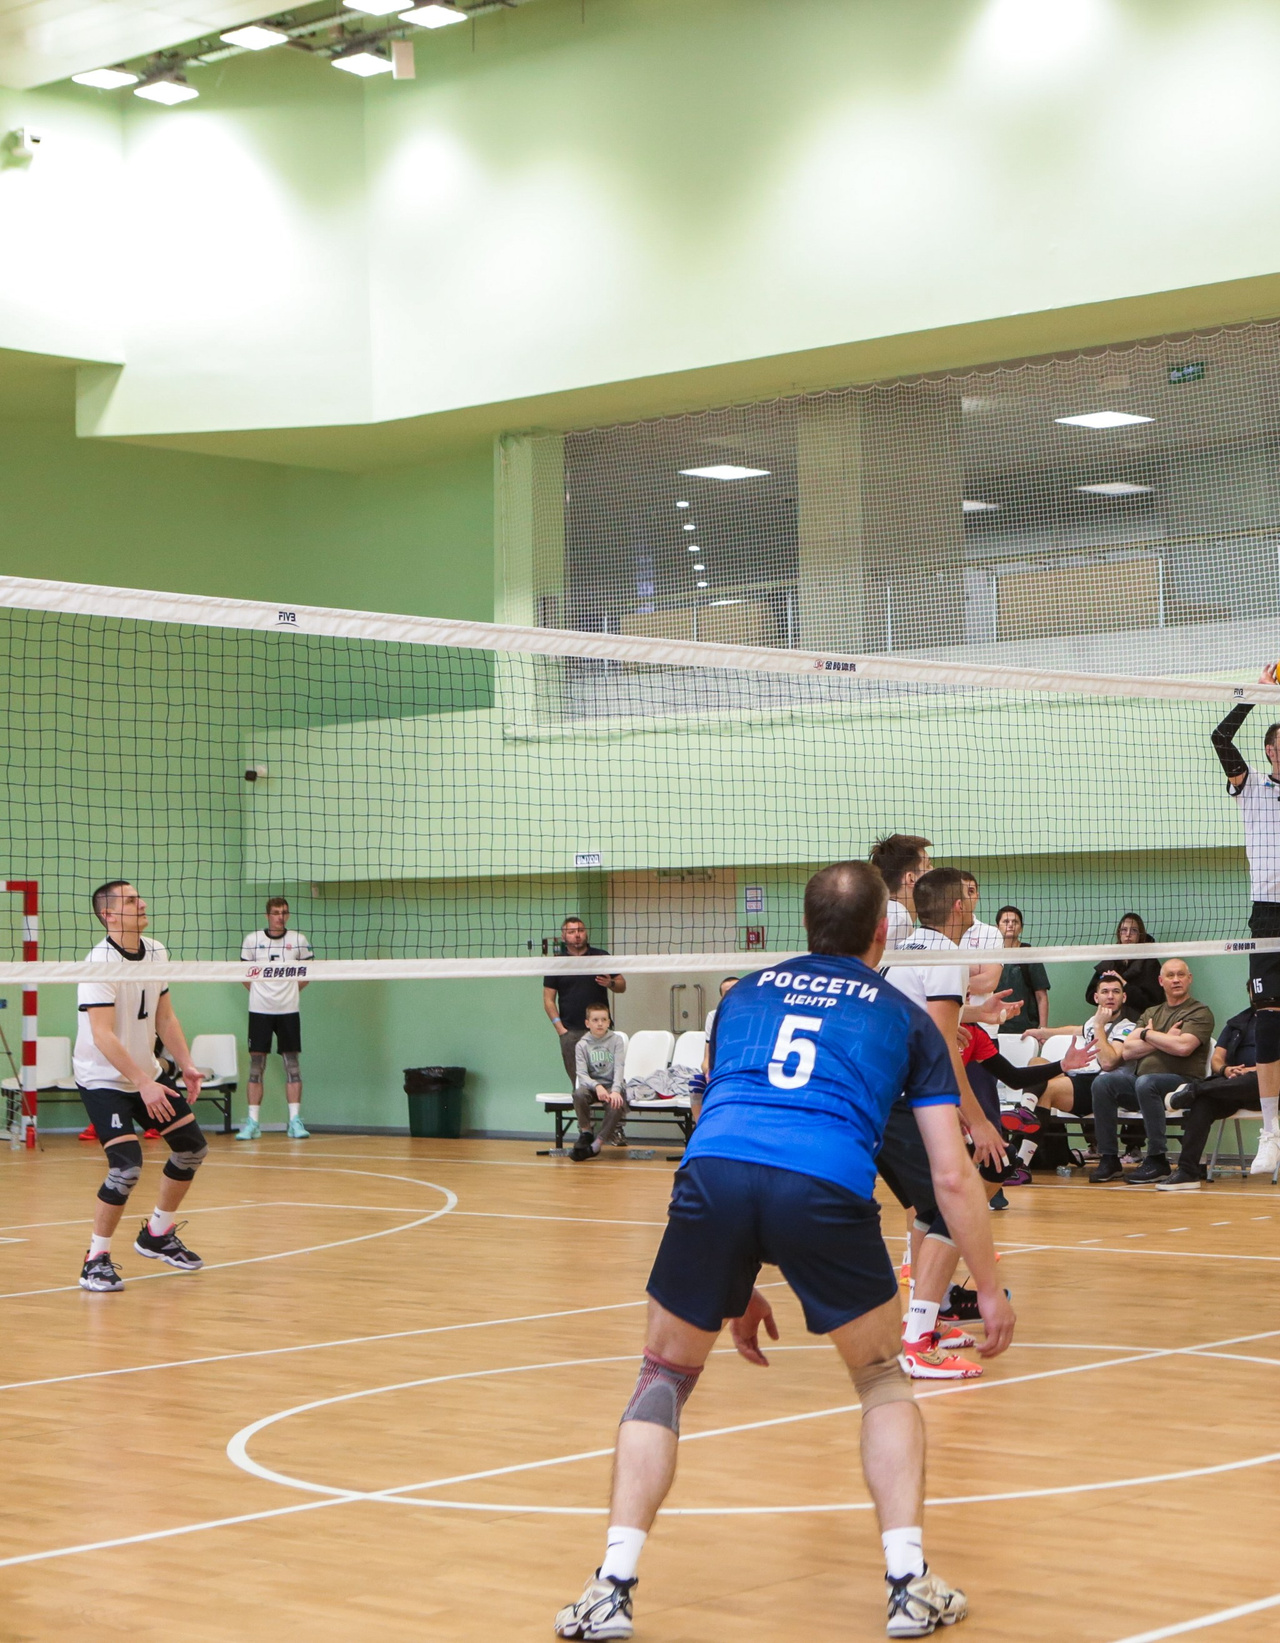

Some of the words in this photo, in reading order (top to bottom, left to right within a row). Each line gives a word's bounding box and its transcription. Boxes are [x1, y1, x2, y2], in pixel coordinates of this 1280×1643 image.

[262, 966, 307, 978] 金陵体育
[757, 970, 879, 1003] РОССЕТИ
[1252, 978, 1264, 994] 15
[783, 993, 838, 1008] ЦЕНТР
[768, 1014, 822, 1089] 5
[110, 1113, 124, 1129] 4
